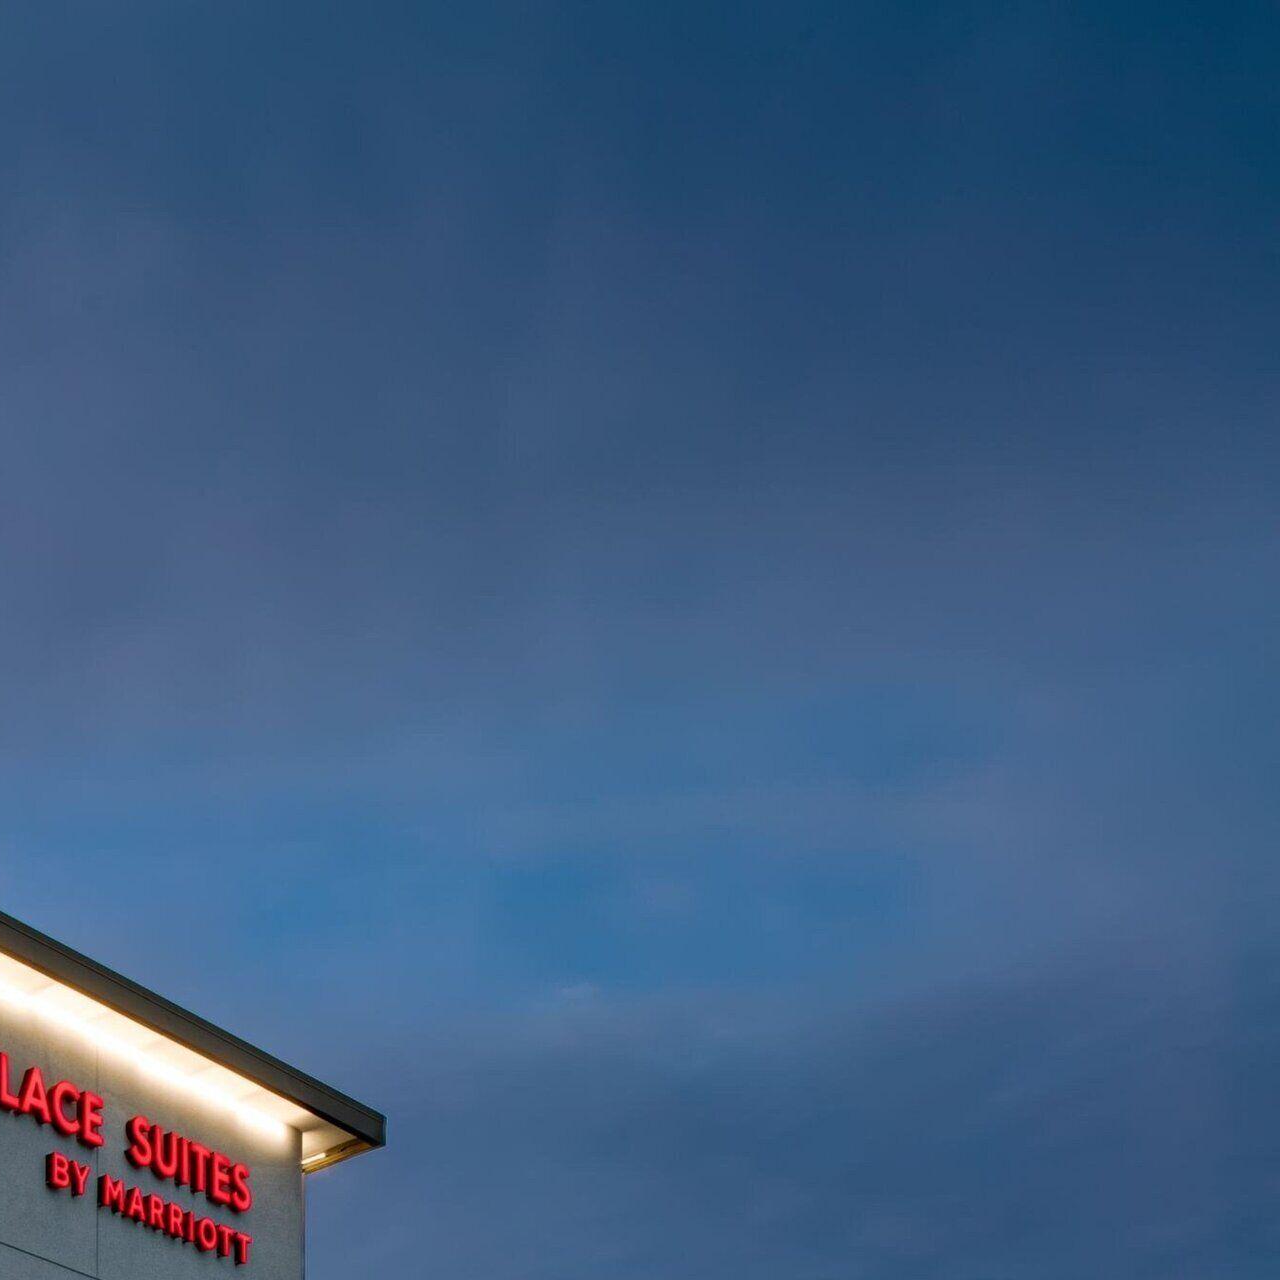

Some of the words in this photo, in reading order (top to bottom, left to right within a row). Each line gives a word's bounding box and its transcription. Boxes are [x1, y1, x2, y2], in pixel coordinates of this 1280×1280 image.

[46, 1151, 91, 1196] BY
[97, 1173, 253, 1265] MARRIOTT
[125, 1114, 253, 1213] SUITES
